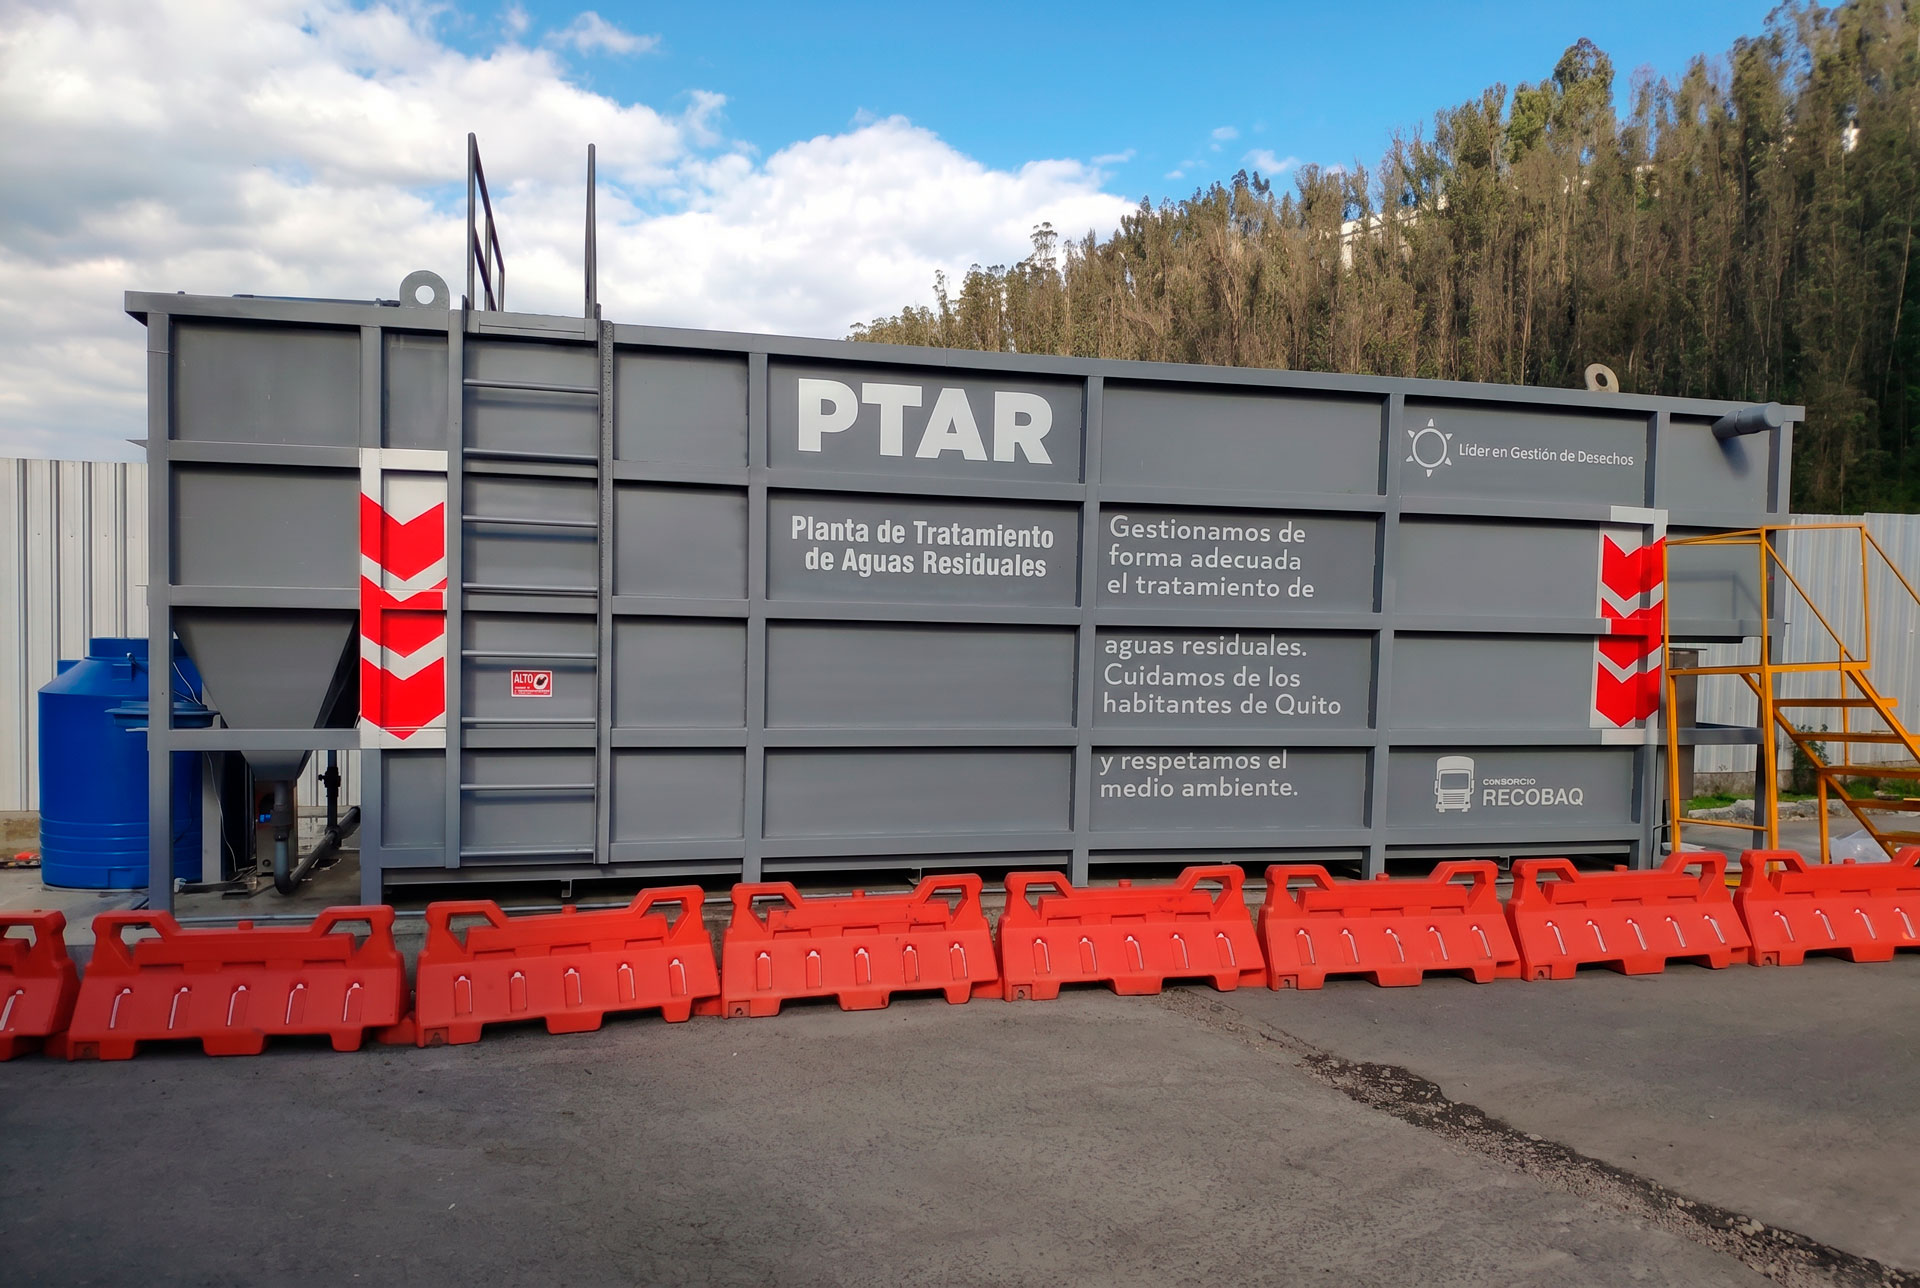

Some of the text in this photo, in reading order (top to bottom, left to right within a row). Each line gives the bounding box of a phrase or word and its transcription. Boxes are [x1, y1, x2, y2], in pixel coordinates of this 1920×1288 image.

[798, 378, 1053, 464] PTAR
[1459, 443, 1634, 465] Líder en Gestión de Desechos
[791, 515, 1054, 549] Planta de Tratamiento
[1109, 514, 1306, 543] Gestionamos de
[805, 547, 1047, 577] de Aguas Residuales
[1108, 543, 1301, 570] forma adecuada
[1107, 572, 1315, 598] el tratamiento de
[1104, 633, 1307, 660] aguas residuales.
[514, 673, 534, 684] ALTO
[1103, 663, 1301, 688] Cuidamos de los
[1103, 692, 1342, 715] habitantes de Quito
[1099, 749, 1287, 775] y respetamos el
[1100, 776, 1299, 798] medio ambiente.
[1482, 778, 1536, 786] CONSORCIO
[1482, 787, 1584, 806] RECOBAQ
